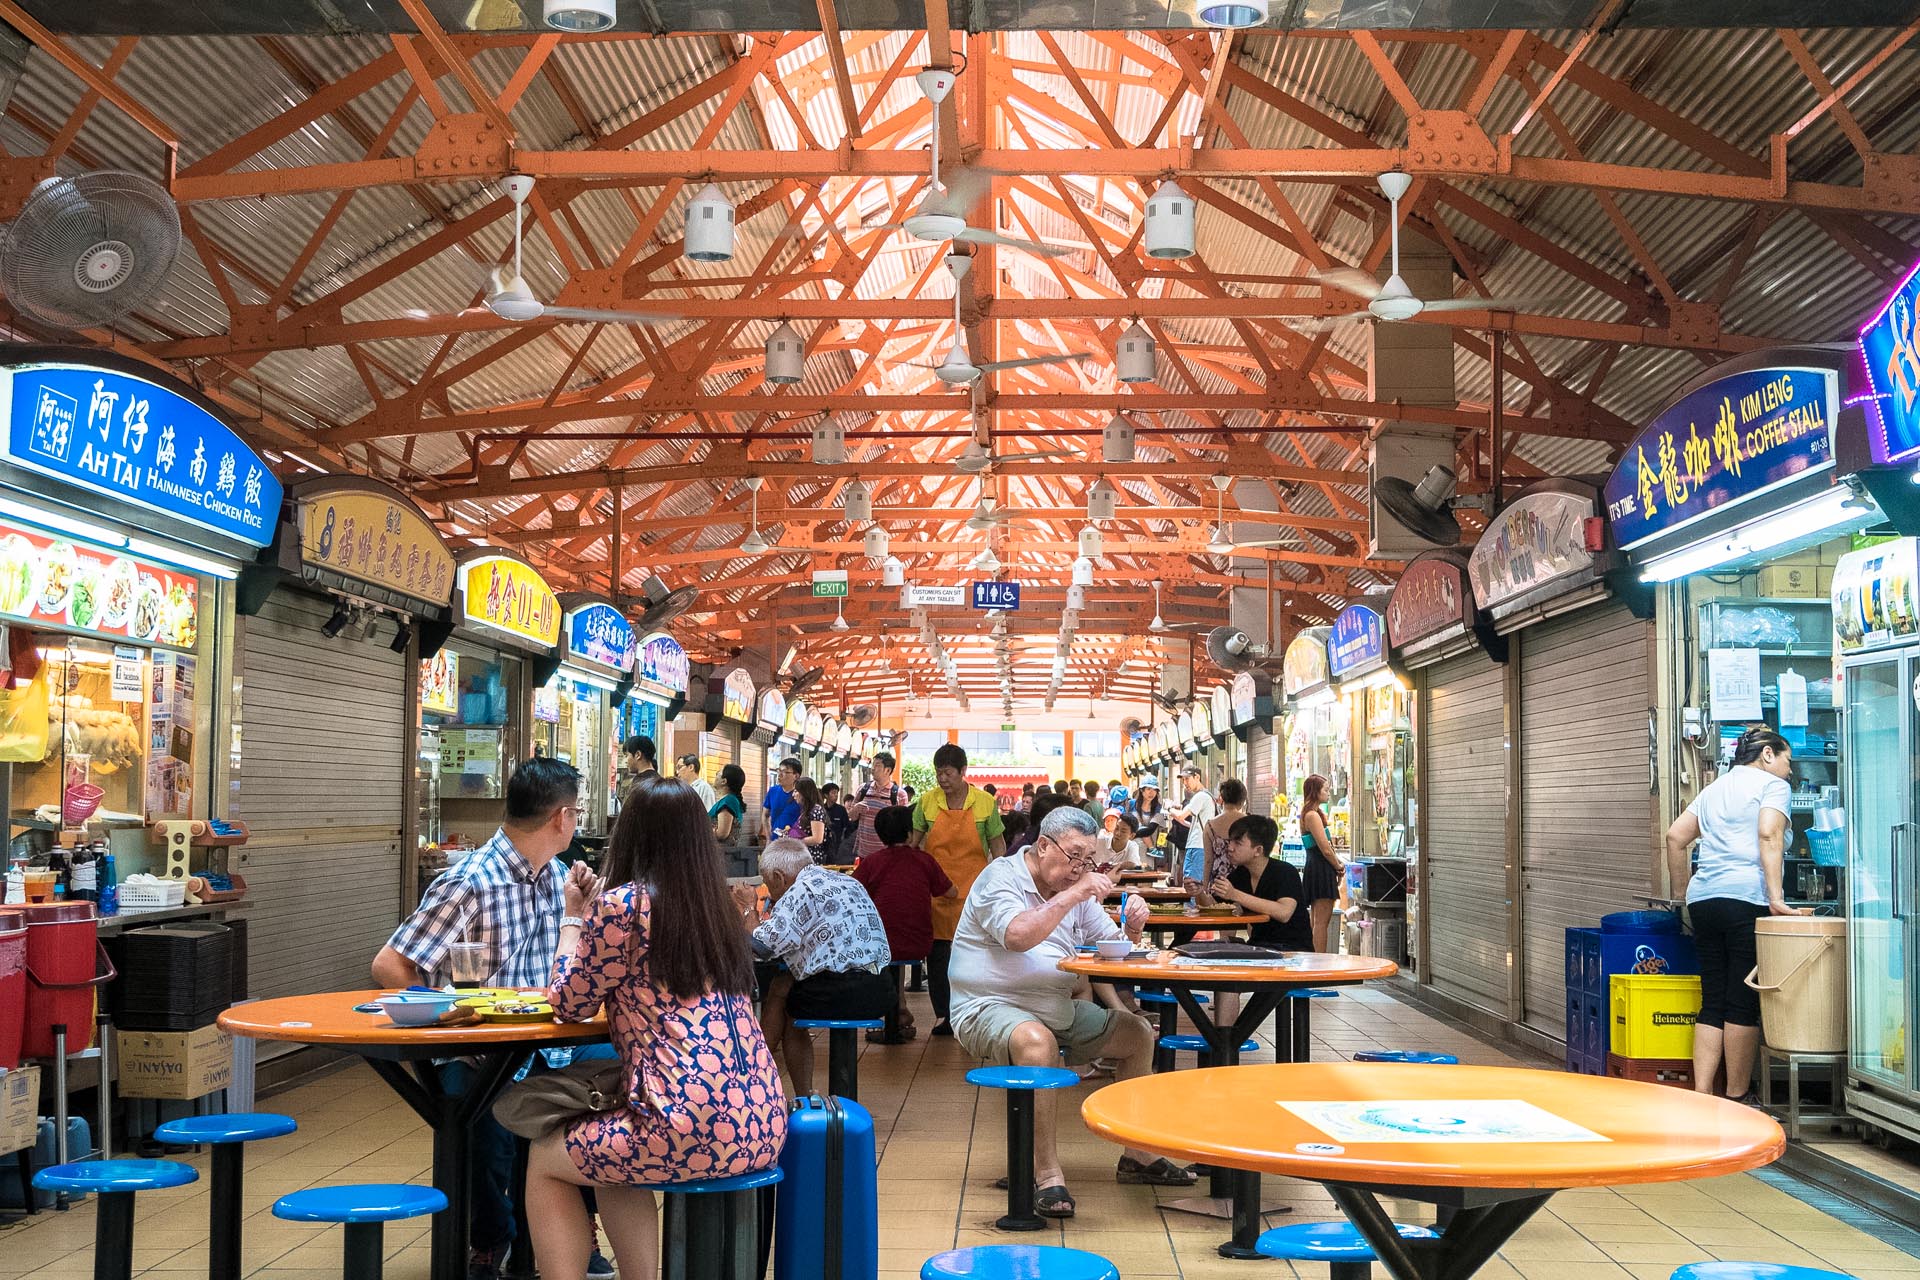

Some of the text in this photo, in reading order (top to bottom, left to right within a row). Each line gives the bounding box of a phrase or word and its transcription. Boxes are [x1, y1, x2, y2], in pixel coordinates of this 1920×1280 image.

[1740, 375, 1794, 424] KIM LENG
[1746, 400, 1824, 458] COFFEE STALL
[1810, 437, 1829, 453] #01-38
[78, 442, 263, 528] AH TAI HAINANESE CHICKEN RICE
[1609, 501, 1621, 521] IT'S
[320, 505, 335, 560] 8
[820, 583, 841, 594] EXIT
[1634, 957, 1667, 974] Tiger
[1655, 1014, 1696, 1024] Heineken
[138, 1060, 183, 1076] DASANI
